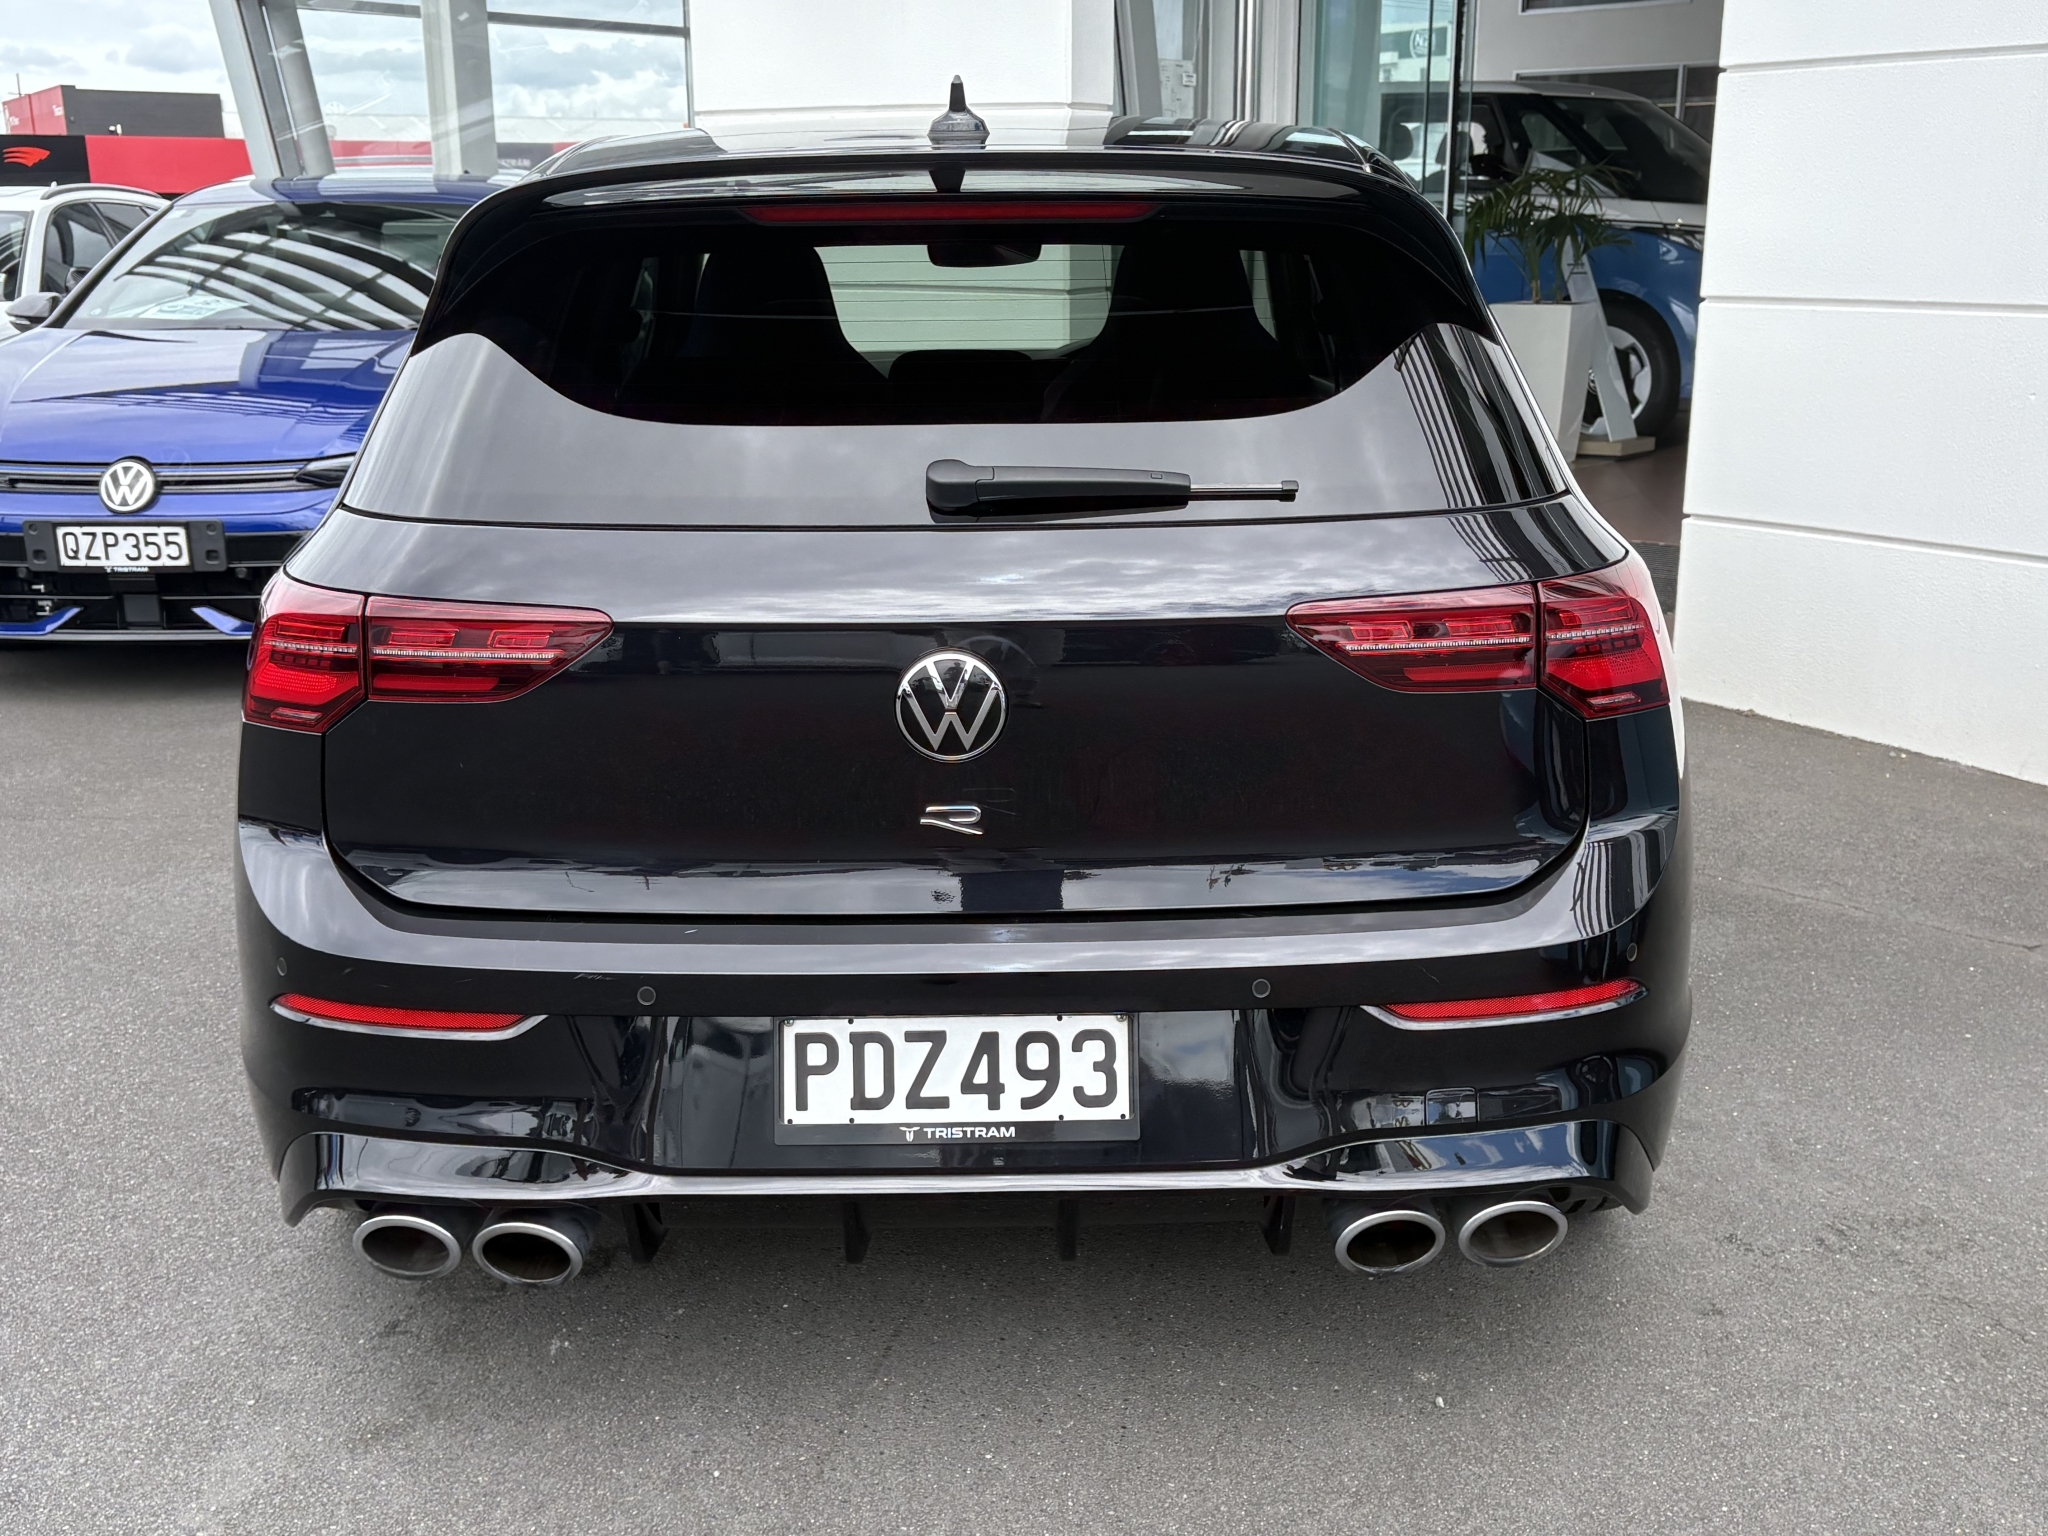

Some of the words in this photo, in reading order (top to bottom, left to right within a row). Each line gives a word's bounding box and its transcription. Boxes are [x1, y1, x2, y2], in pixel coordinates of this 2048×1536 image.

[61, 532, 183, 561] QZP355
[794, 1028, 1118, 1112] PDZ493
[922, 1126, 1016, 1139] TRISTRAM
